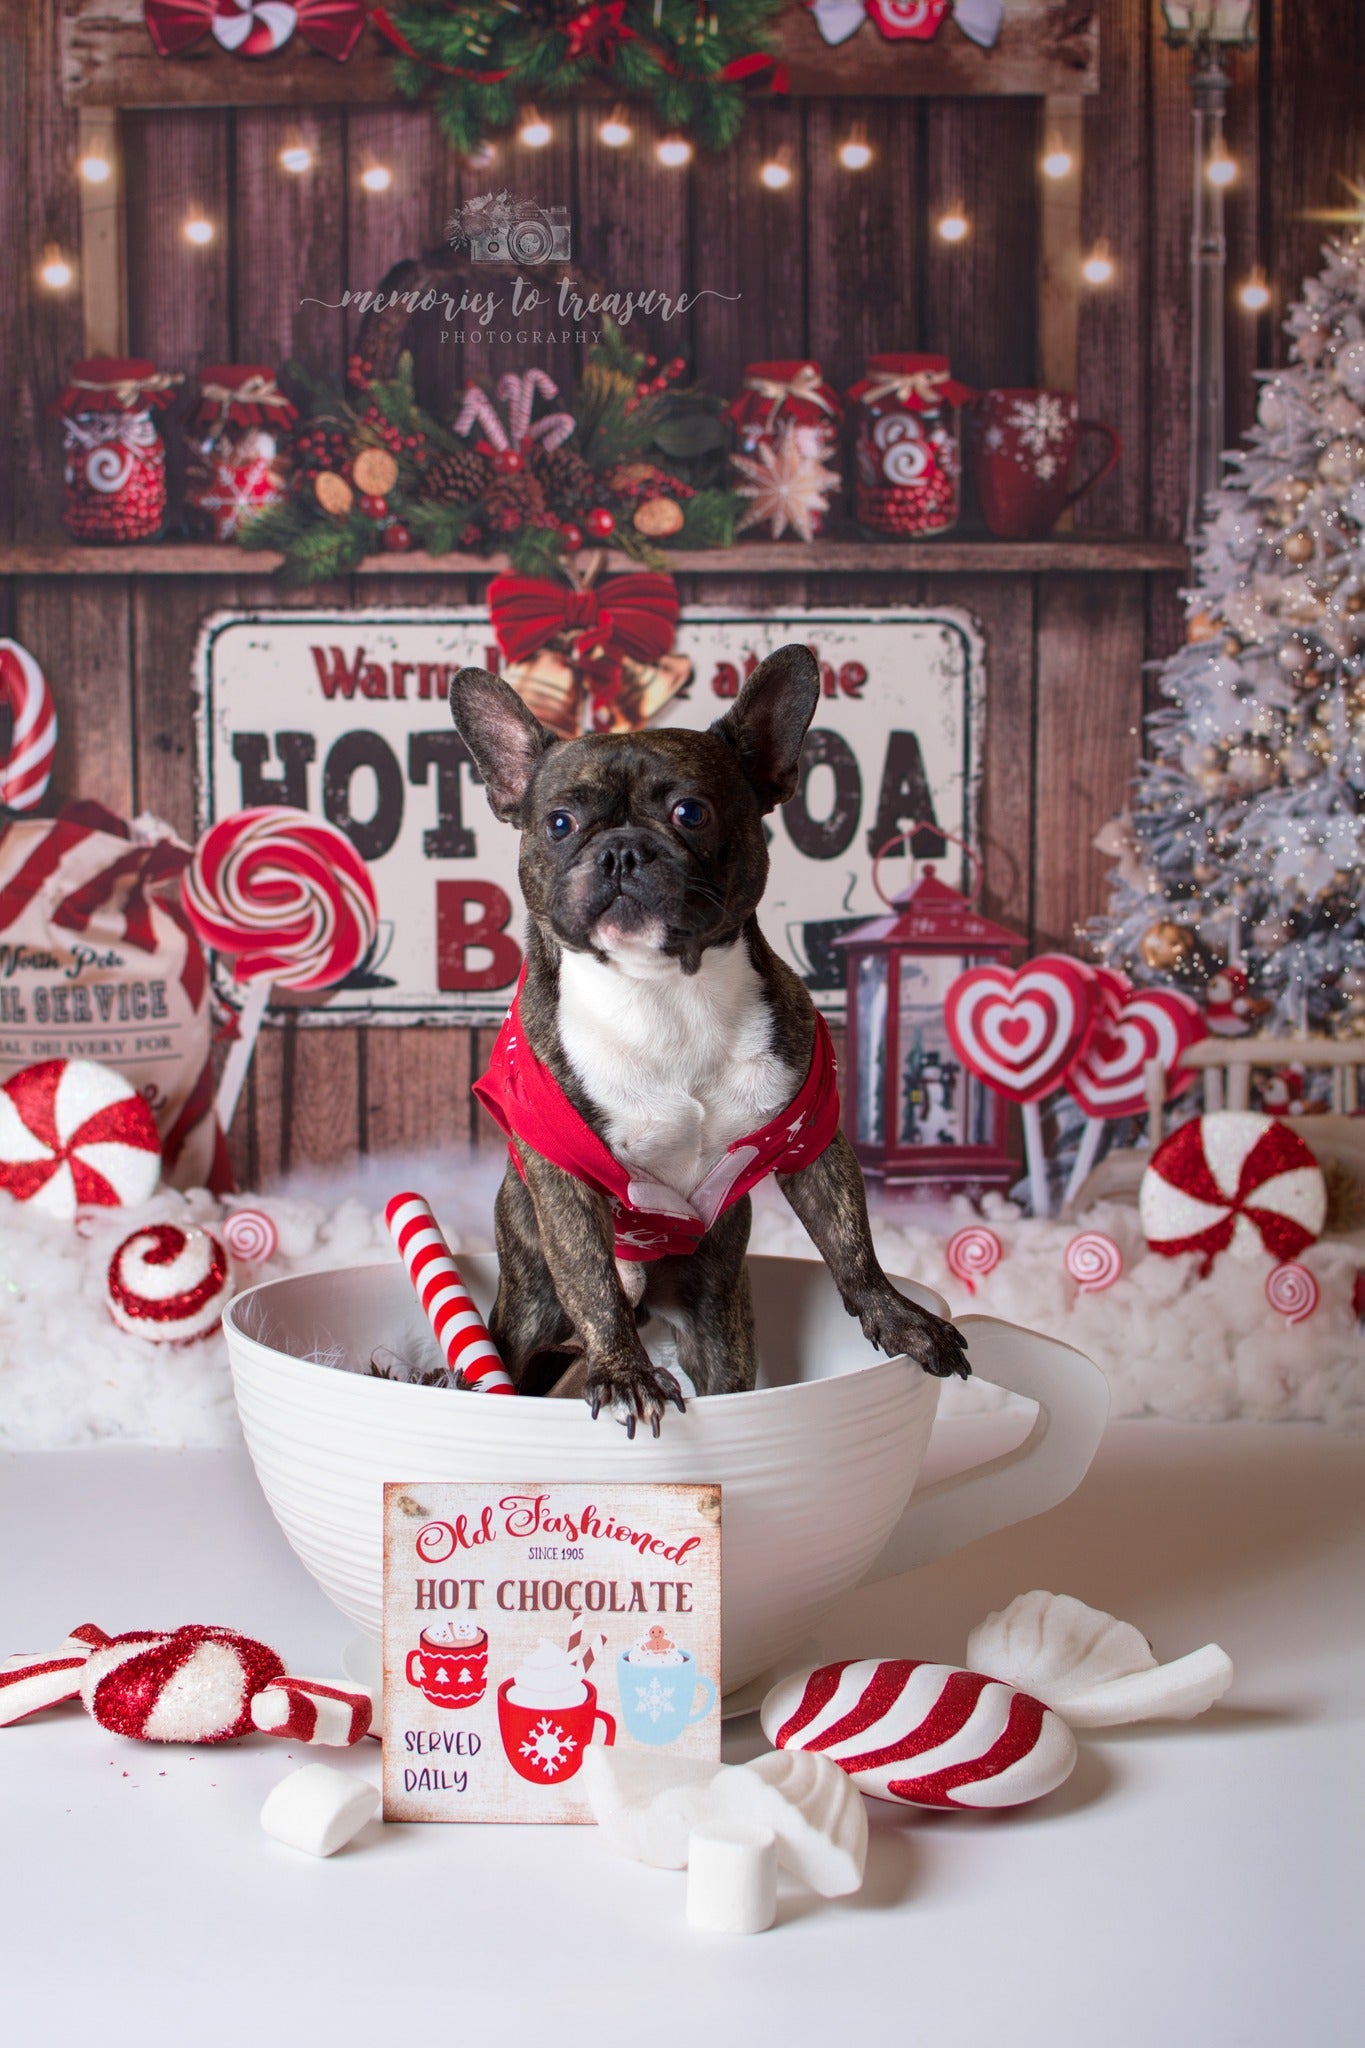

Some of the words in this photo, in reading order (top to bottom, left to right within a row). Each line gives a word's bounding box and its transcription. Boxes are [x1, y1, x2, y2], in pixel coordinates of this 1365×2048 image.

[309, 645, 463, 700] Warm
[807, 644, 869, 698] he
[231, 729, 486, 861] HOT
[34, 980, 169, 1023] SERVICE
[32, 1038, 126, 1055] DELIVERY
[135, 1036, 172, 1050] FOR
[415, 1506, 496, 1564] Old
[499, 1494, 701, 1566] Fashioned
[528, 1547, 558, 1560] SINCE
[560, 1547, 585, 1560] 1905
[414, 1578, 485, 1611] HOT
[496, 1579, 693, 1613] CHOCOLATE
[404, 1730, 482, 1757] SERVED
[404, 1767, 469, 1793] DAILY
